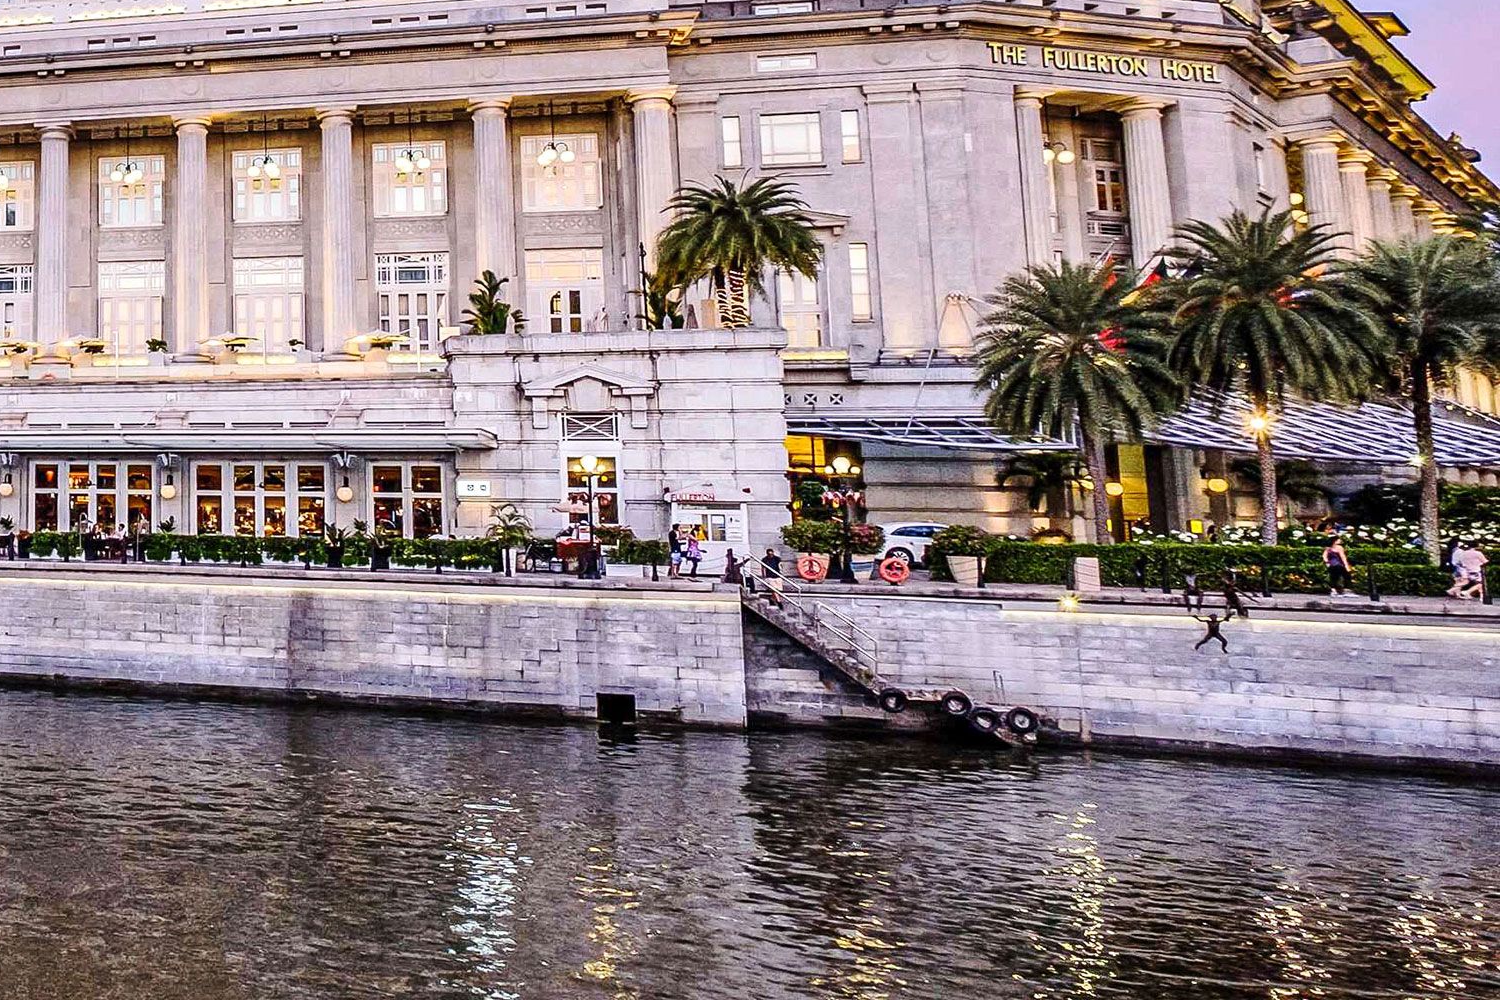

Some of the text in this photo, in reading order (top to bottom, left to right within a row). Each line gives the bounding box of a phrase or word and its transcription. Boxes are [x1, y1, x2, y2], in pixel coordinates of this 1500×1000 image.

[987, 42, 1222, 83] THE FULLERTON HOTEL
